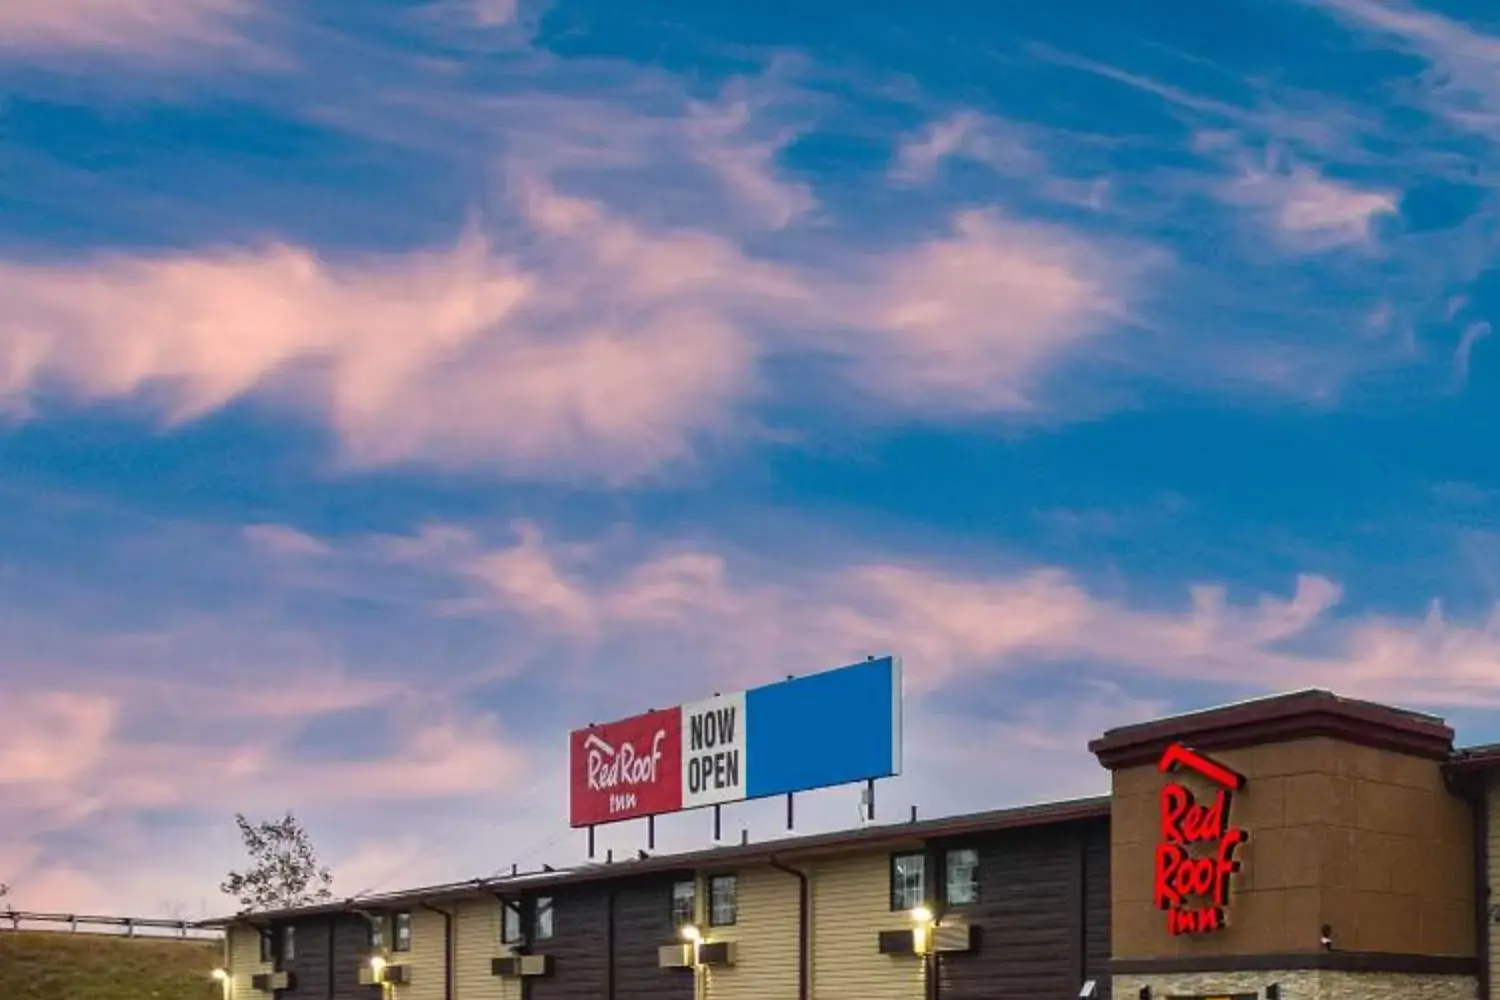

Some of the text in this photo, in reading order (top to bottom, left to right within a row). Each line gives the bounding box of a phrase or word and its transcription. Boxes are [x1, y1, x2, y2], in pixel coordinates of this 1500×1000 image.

[690, 706, 736, 750] NOW
[588, 729, 666, 791] Red Roof
[688, 750, 739, 794] OPEN
[1159, 784, 1226, 845] Red
[1154, 826, 1242, 909] Roof
